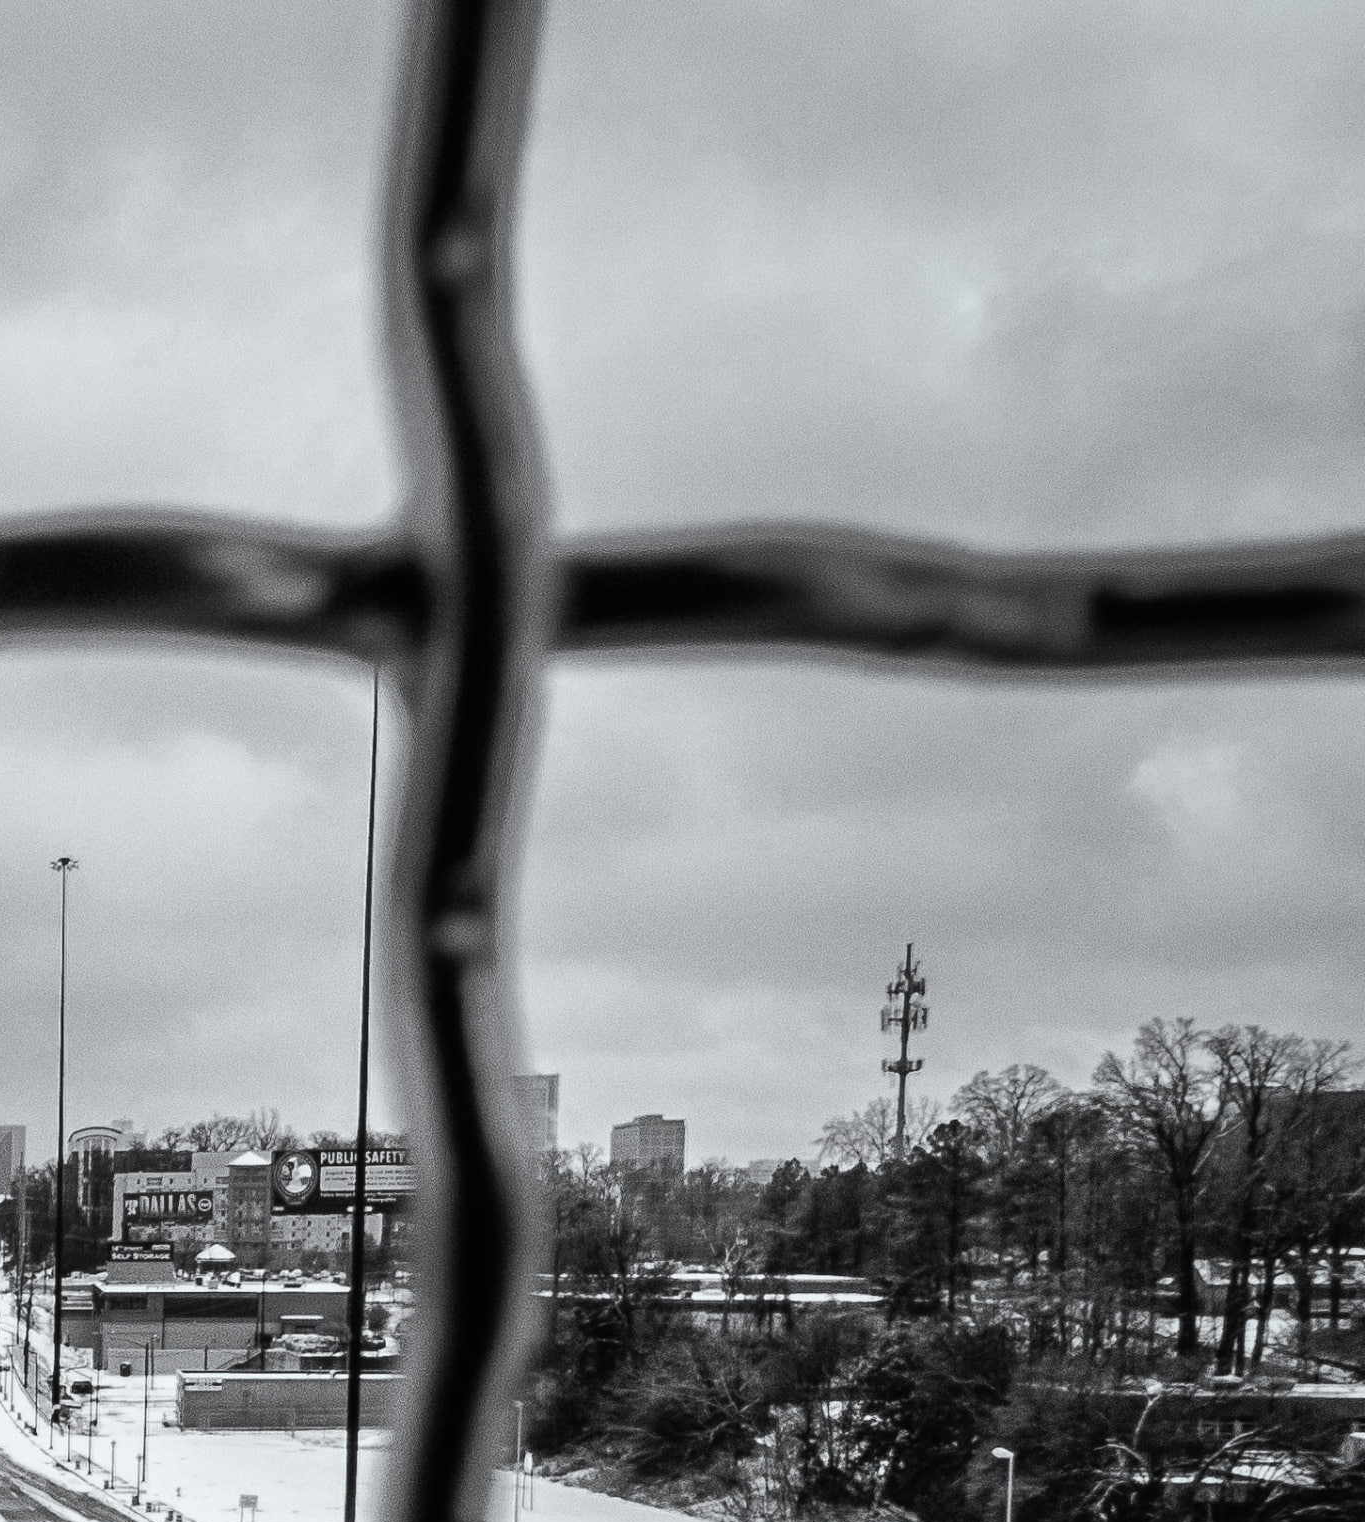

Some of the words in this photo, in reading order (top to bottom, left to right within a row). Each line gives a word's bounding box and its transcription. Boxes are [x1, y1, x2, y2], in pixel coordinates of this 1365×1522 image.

[365, 1150, 406, 1164] SAFETY
[139, 1193, 197, 1217] DALLAS
[132, 1252, 171, 1260] STORAGE
